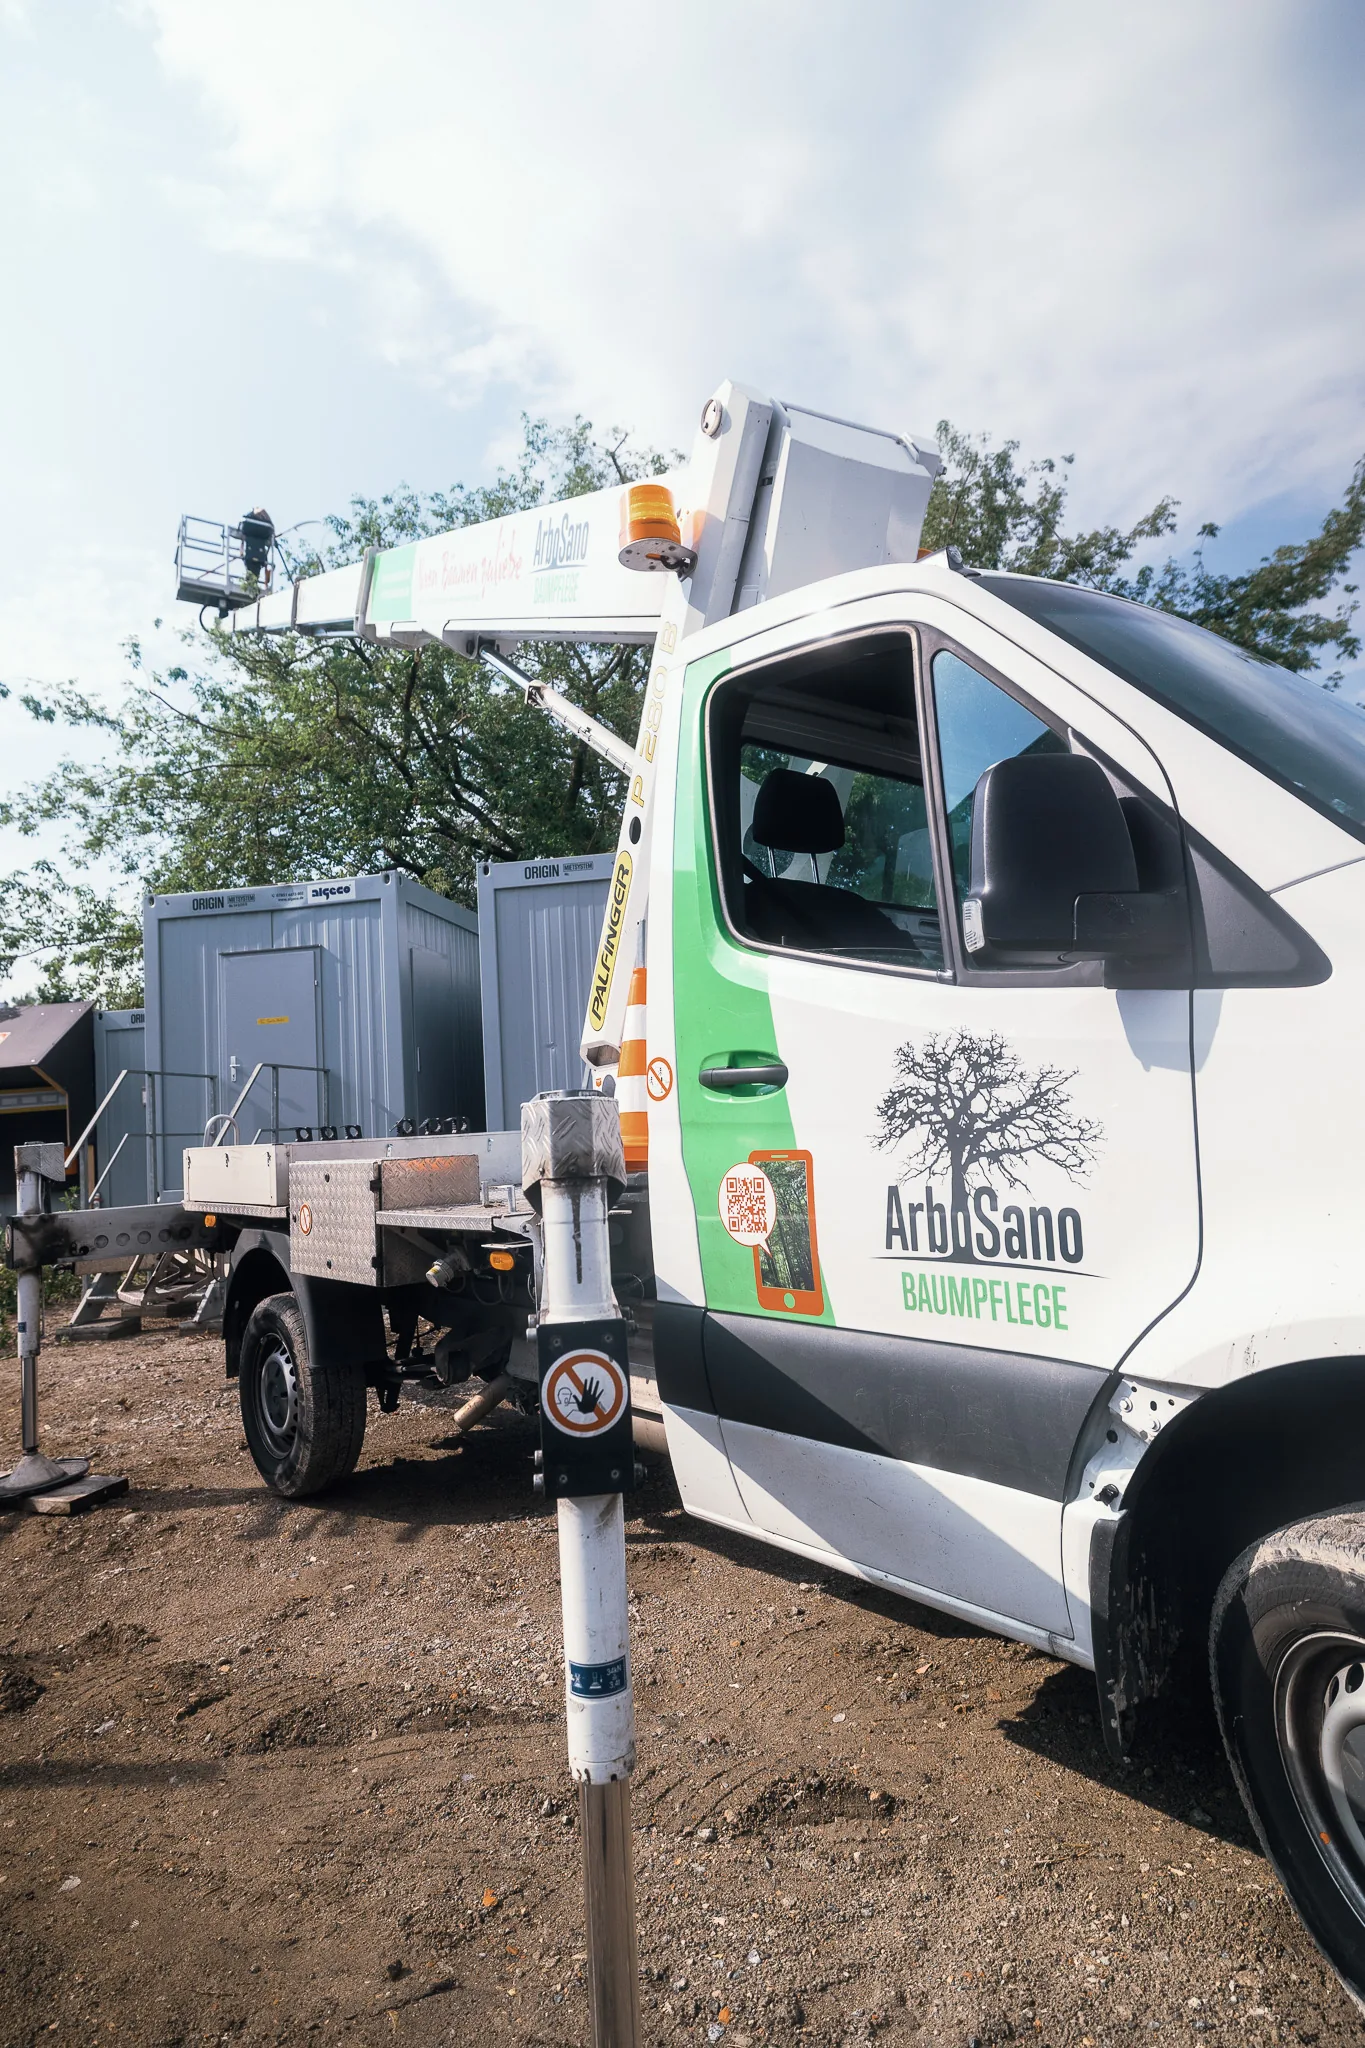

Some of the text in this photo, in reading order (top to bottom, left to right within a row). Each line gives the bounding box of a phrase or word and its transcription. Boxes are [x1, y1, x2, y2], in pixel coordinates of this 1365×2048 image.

[533, 513, 590, 567] ArboSano
[524, 861, 594, 880] ORIGIN MIETSYSTEM
[192, 896, 225, 911] ORIGIN
[311, 885, 351, 900] algeco
[591, 863, 630, 1022] PALFINGER
[130, 1013, 145, 1025] ORI
[885, 1184, 1084, 1264] ArboSano
[900, 1271, 1069, 1331] BAUMPFLEGE
